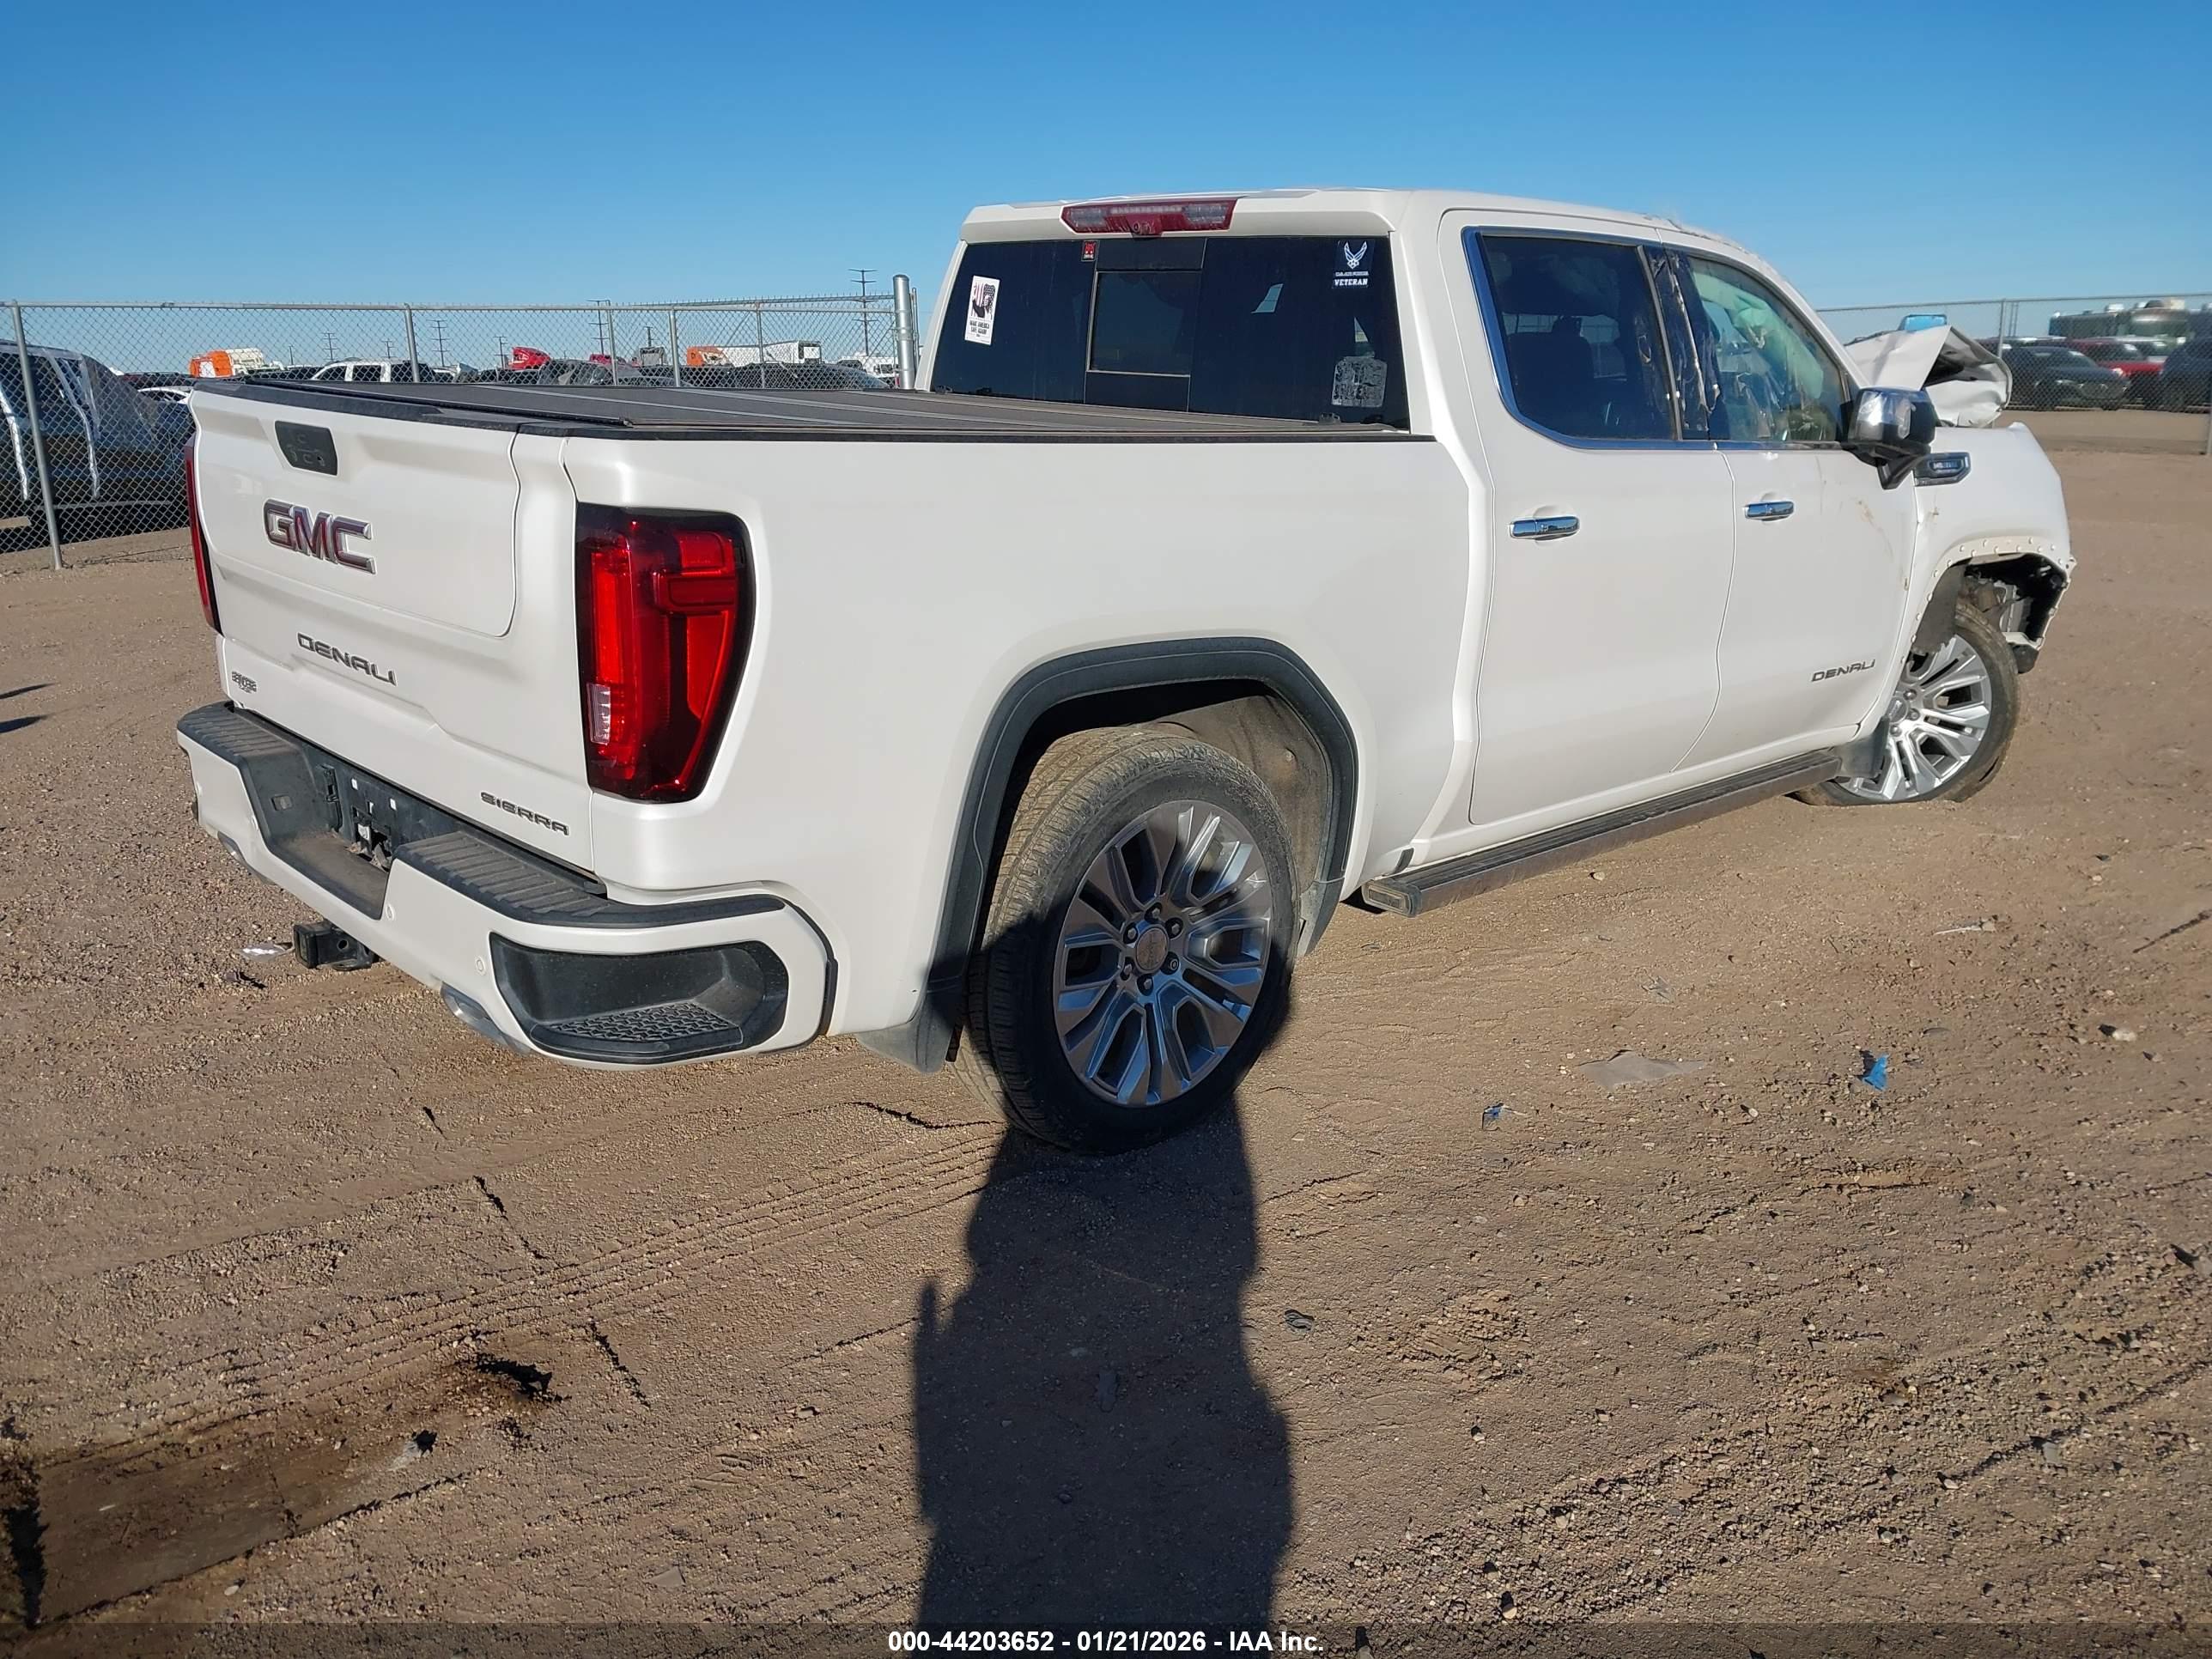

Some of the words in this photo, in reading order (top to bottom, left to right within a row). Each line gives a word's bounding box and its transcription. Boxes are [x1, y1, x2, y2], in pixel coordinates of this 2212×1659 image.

[263, 499, 376, 574] GMC
[297, 633, 398, 686] DENALI
[1812, 659, 1875, 682] DENALI
[481, 792, 569, 836] SIERRA
